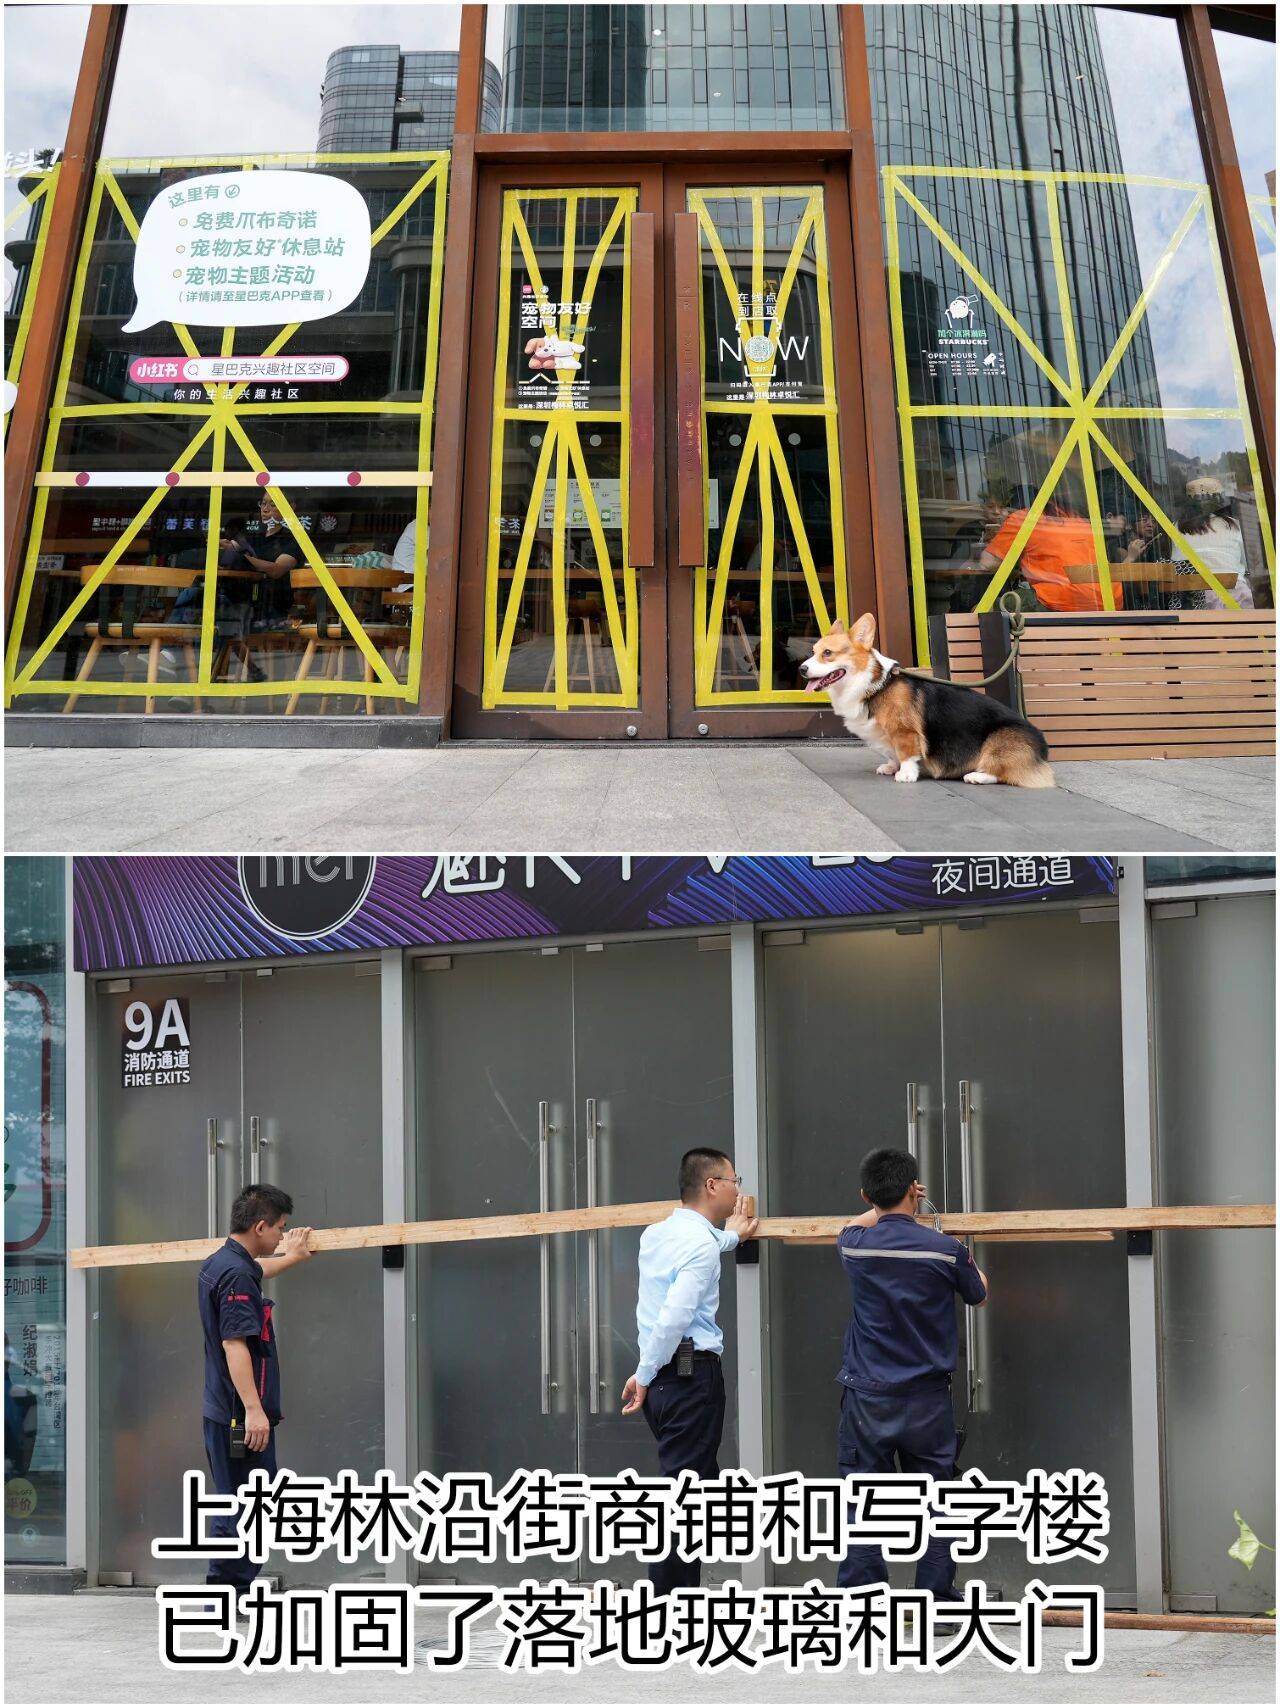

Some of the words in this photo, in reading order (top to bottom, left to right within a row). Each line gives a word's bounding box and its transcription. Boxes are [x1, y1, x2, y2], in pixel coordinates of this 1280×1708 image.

[168, 184, 221, 209] 这里有
[193, 210, 317, 231] 免费爪布奇诺
[184, 264, 316, 286] 宠物主题活动
[737, 292, 778, 303] 在线点
[521, 302, 592, 315] 宠物友好
[737, 305, 778, 317] 到店取
[521, 316, 557, 329] 空间
[137, 363, 179, 378] 小红书
[211, 362, 336, 376] 星巴克兴趣社区空间
[173, 388, 300, 400] 你的生活兴趣社区
[931, 856, 1075, 895] 夜间通道
[124, 998, 190, 1051] 9A
[124, 1049, 190, 1073] 消防通道
[124, 1072, 153, 1087] FIRE
[154, 1069, 191, 1086] EXITS
